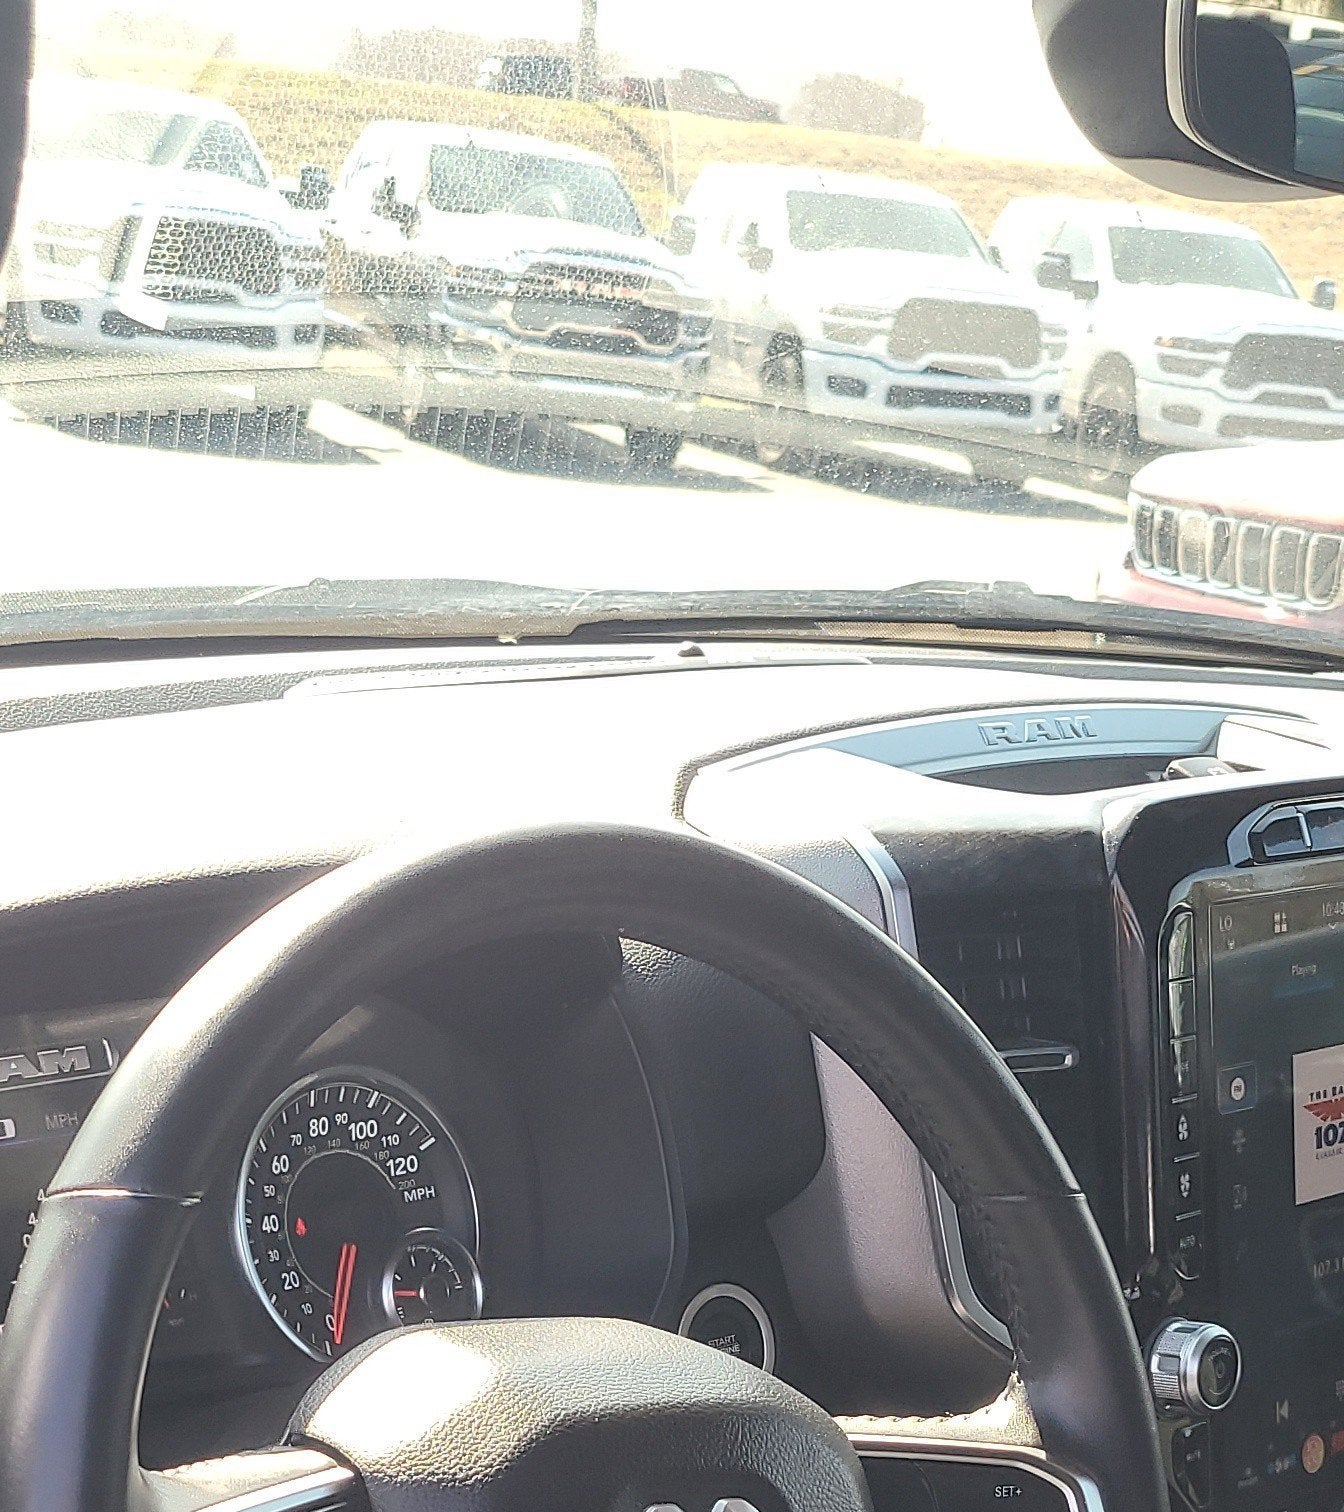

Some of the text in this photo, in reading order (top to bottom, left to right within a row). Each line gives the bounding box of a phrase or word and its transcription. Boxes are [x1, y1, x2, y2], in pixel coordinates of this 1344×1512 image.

[977, 715, 1097, 746] RAM
[1218, 915, 1233, 931] LO
[1309, 1089, 1327, 1102] THE
[45, 1112, 79, 1131] MPH
[309, 1116, 329, 1137] 80
[335, 1112, 348, 1126] 90
[347, 1119, 378, 1141] 100
[290, 1133, 303, 1147] 70
[381, 1133, 400, 1149] 110
[271, 1154, 290, 1175] 60
[386, 1154, 418, 1178] 120
[263, 1184, 276, 1198] 50
[403, 1185, 436, 1203] MPH
[261, 1214, 280, 1234] 40
[267, 1249, 280, 1262] 30
[281, 1271, 300, 1291] 20
[301, 1302, 313, 1316] 10
[707, 1334, 736, 1347] START
